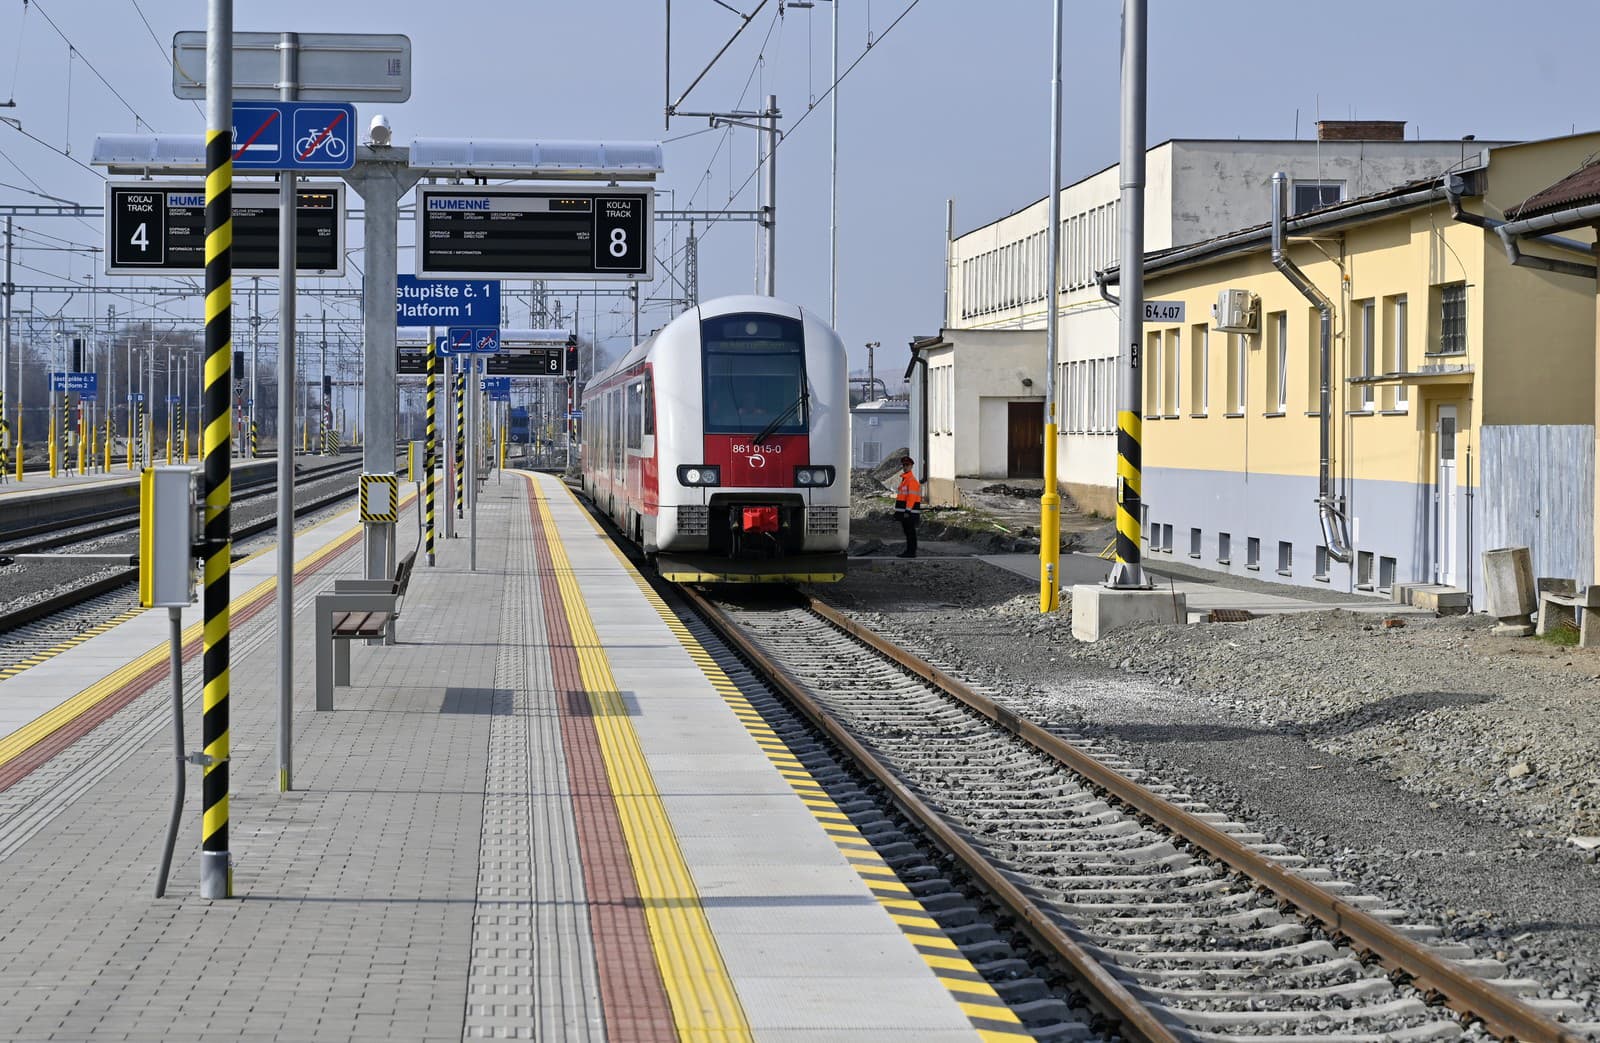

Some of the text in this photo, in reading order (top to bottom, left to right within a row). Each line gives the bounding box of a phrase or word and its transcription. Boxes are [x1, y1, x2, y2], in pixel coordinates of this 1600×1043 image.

[128, 195, 153, 204] KOĽAJ
[169, 196, 205, 206] HUME
[430, 198, 490, 210] HUMENNÉ
[606, 201, 631, 209] KOĽAJ
[128, 204, 153, 212] TRACK
[606, 210, 632, 218] TRACK
[130, 222, 150, 252] 4
[609, 227, 628, 258] 8
[396, 283, 490, 301] stupište č. 1
[464, 303, 472, 317] 1
[1145, 304, 1180, 319] 64.407
[550, 359, 557, 370] 8
[732, 444, 782, 453] 861 015-0
